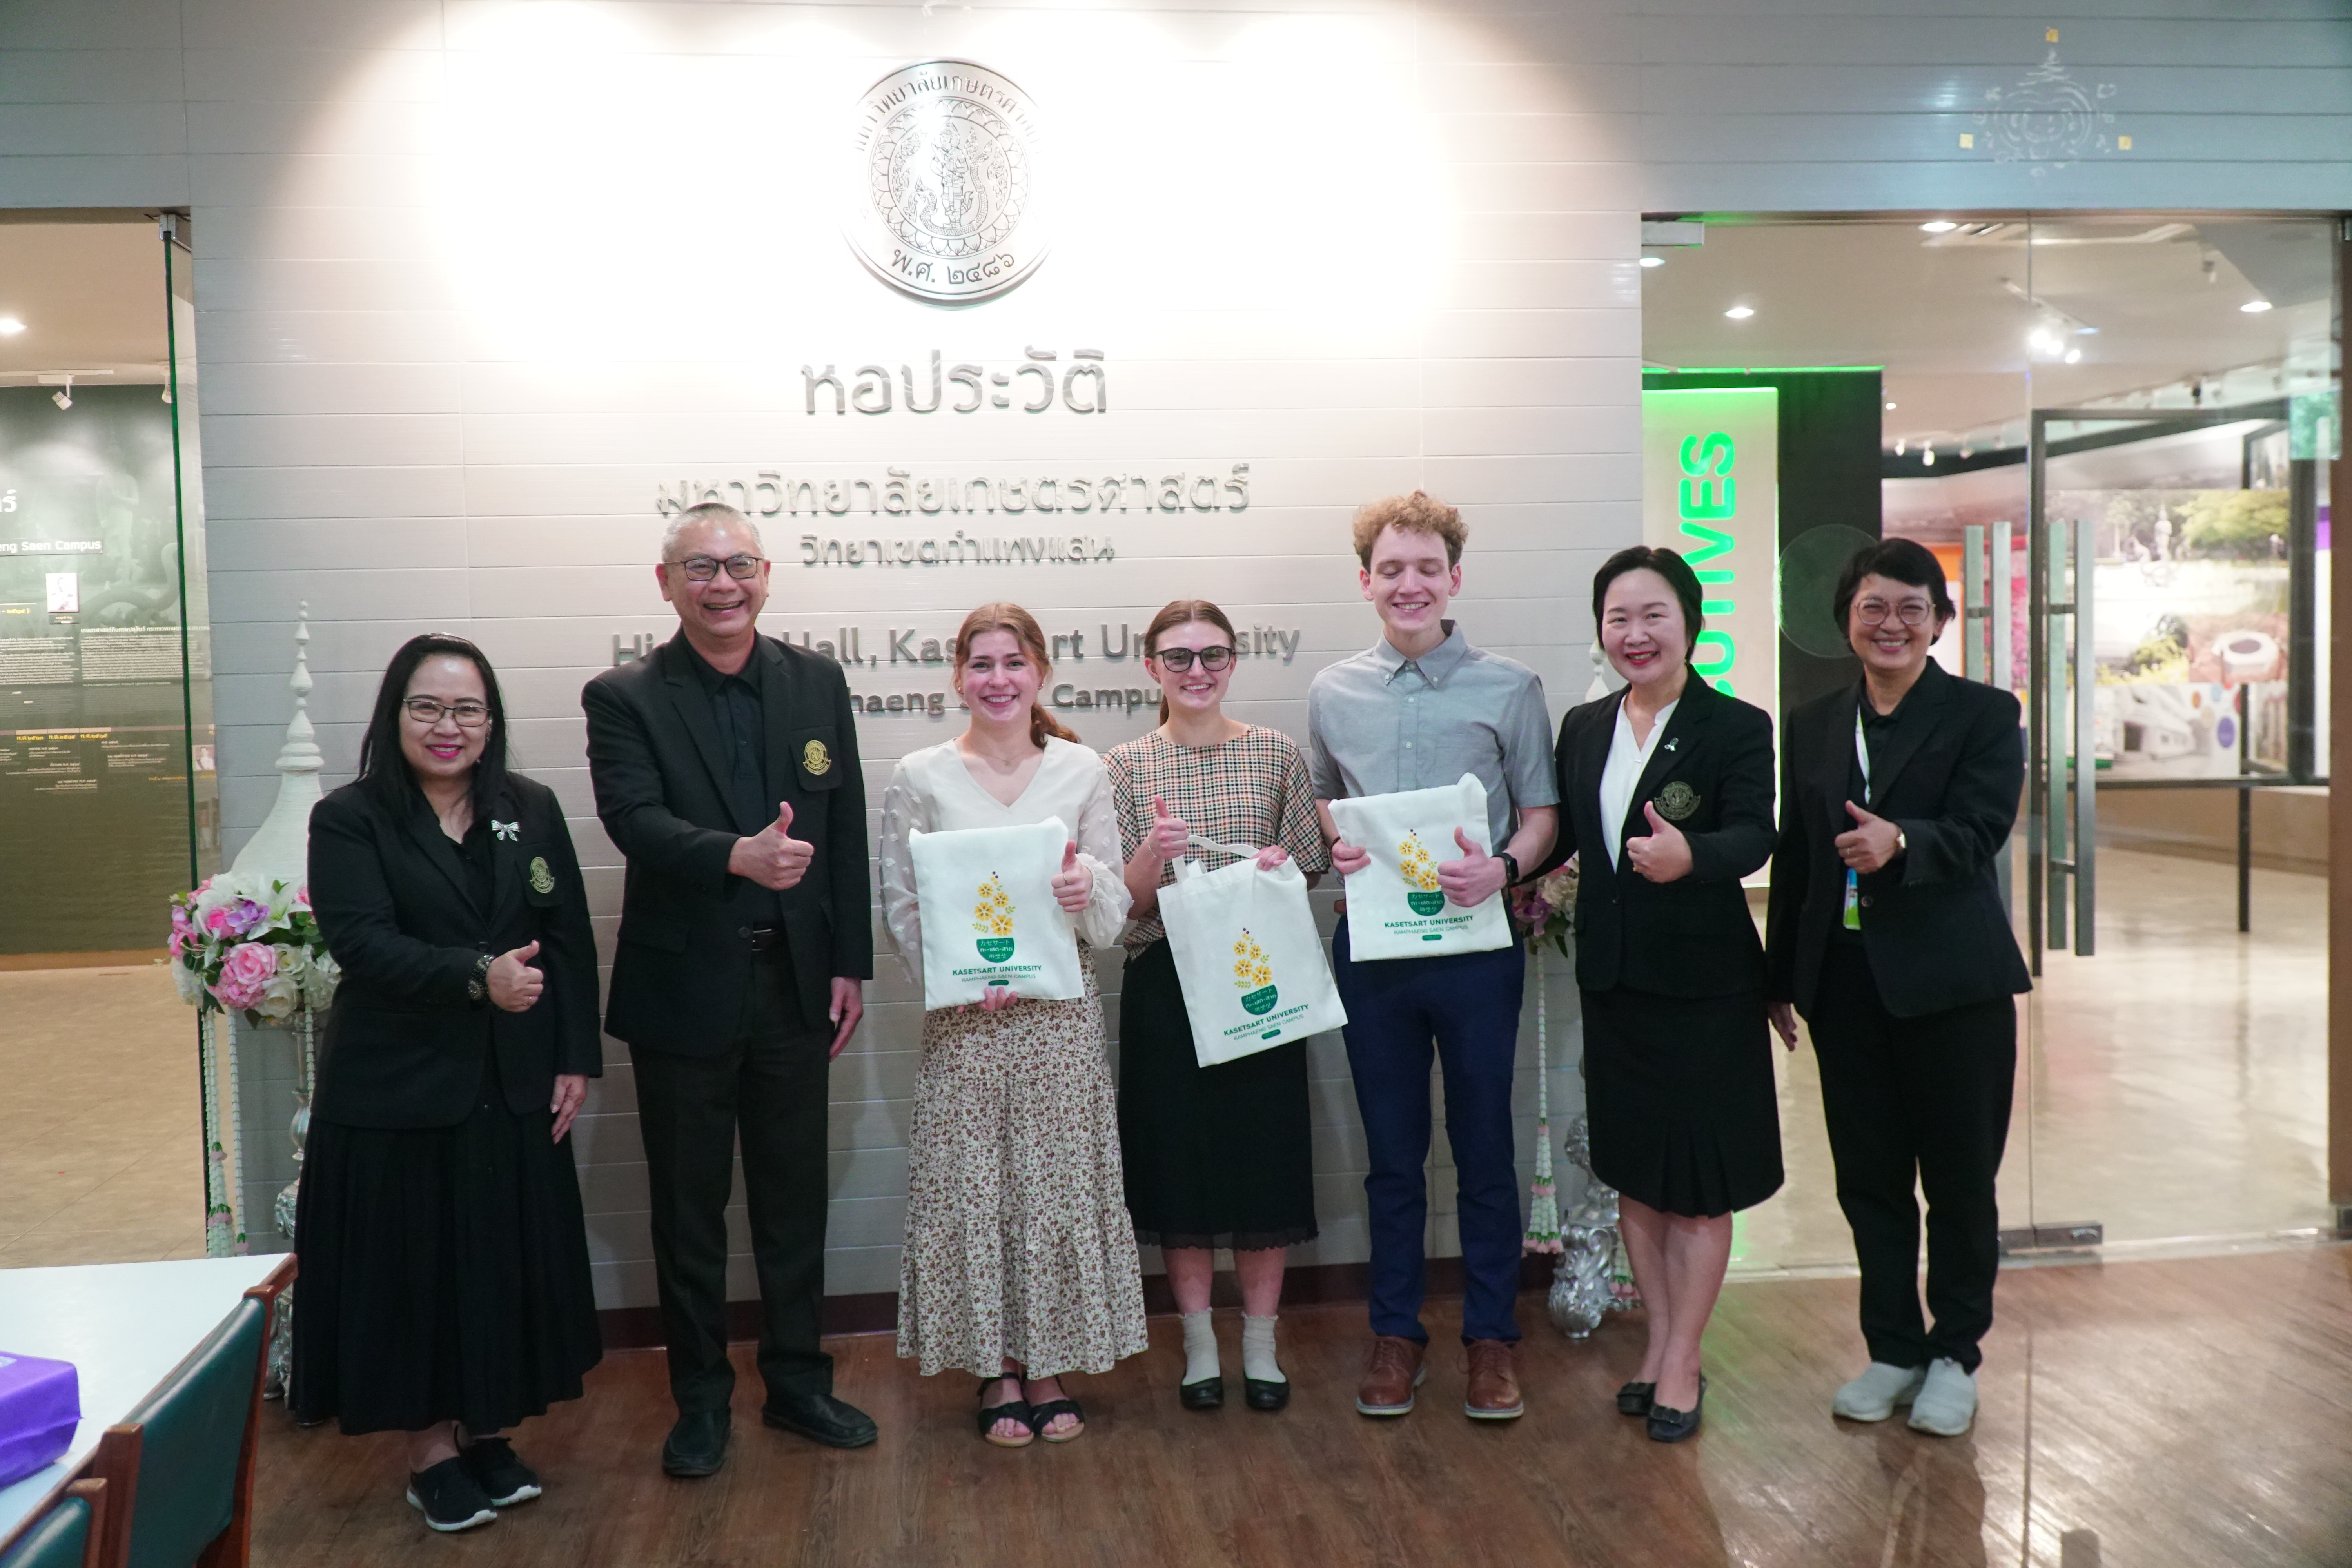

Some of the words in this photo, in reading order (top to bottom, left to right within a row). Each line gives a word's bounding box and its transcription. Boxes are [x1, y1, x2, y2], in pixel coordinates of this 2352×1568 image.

[892, 248, 935, 283] พ.ศ.
[947, 250, 1014, 285] ๒๔๘๖
[800, 344, 1107, 413] หอประวัติ
[21, 541, 51, 551] Saen
[55, 541, 102, 552] Campus
[800, 530, 1115, 564] วิทยาเขตกำแพงแสน
[889, 629, 1083, 662] Kasrt
[1101, 623, 1300, 660] Unsity
[1052, 684, 1161, 714] Campu
[1430, 915, 1473, 926] UNIVERSITY
[952, 967, 997, 976] KASETSART
[1224, 1019, 1265, 1036] KASETSART
[1266, 1004, 1309, 1022] UNIVERSITY
[1234, 1026, 1266, 1041] KAMPHAENG
[1267, 1022, 1281, 1031] SAEN
[1283, 1014, 1304, 1025] CAMPUS
